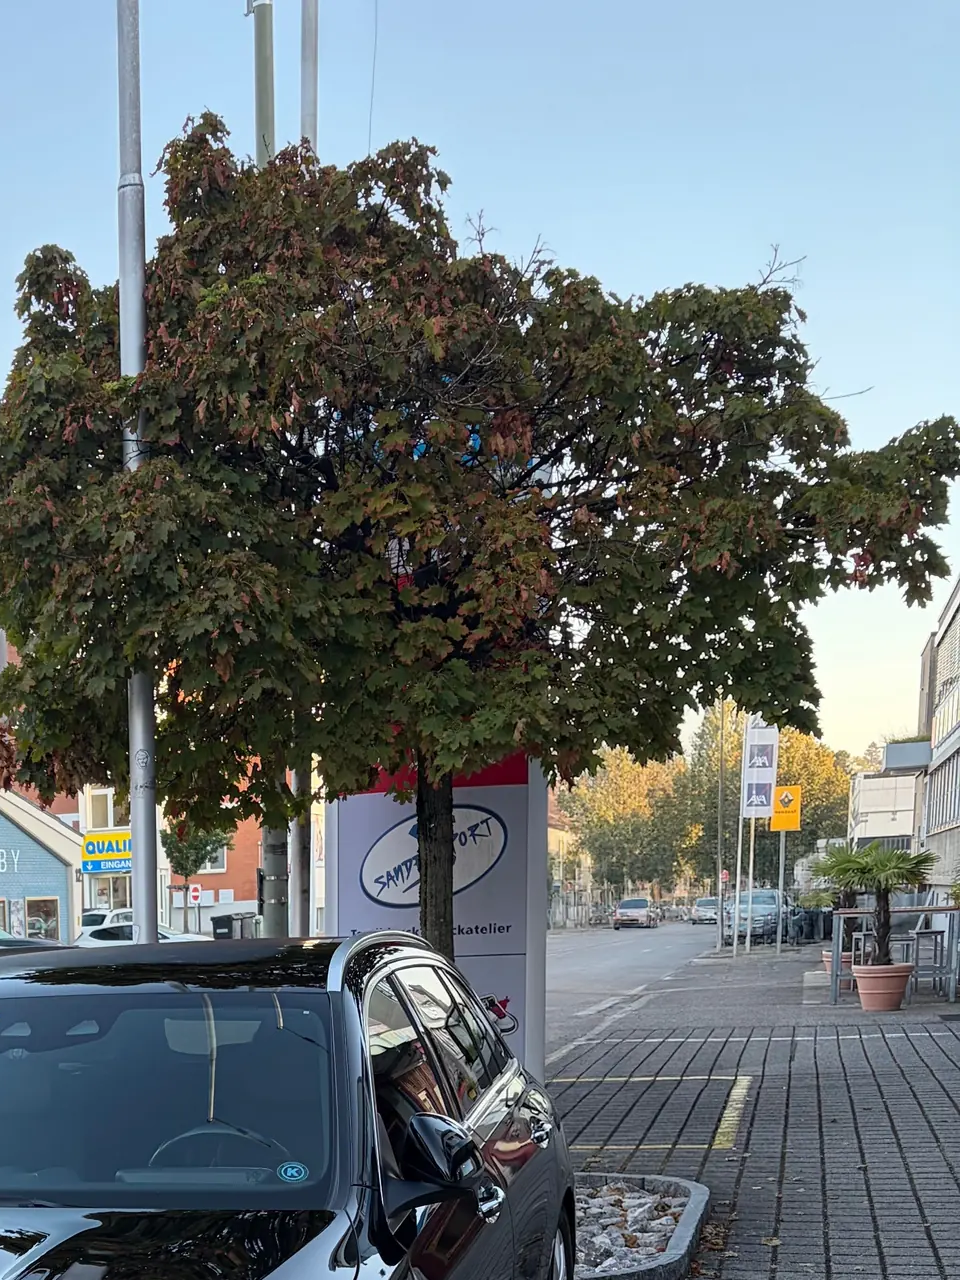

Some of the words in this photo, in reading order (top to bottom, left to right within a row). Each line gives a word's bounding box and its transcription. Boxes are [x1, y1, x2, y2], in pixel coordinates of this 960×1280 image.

[748, 756, 769, 767] AXA
[746, 795, 767, 805] AXA
[101, 860, 132, 869] EINGAN
